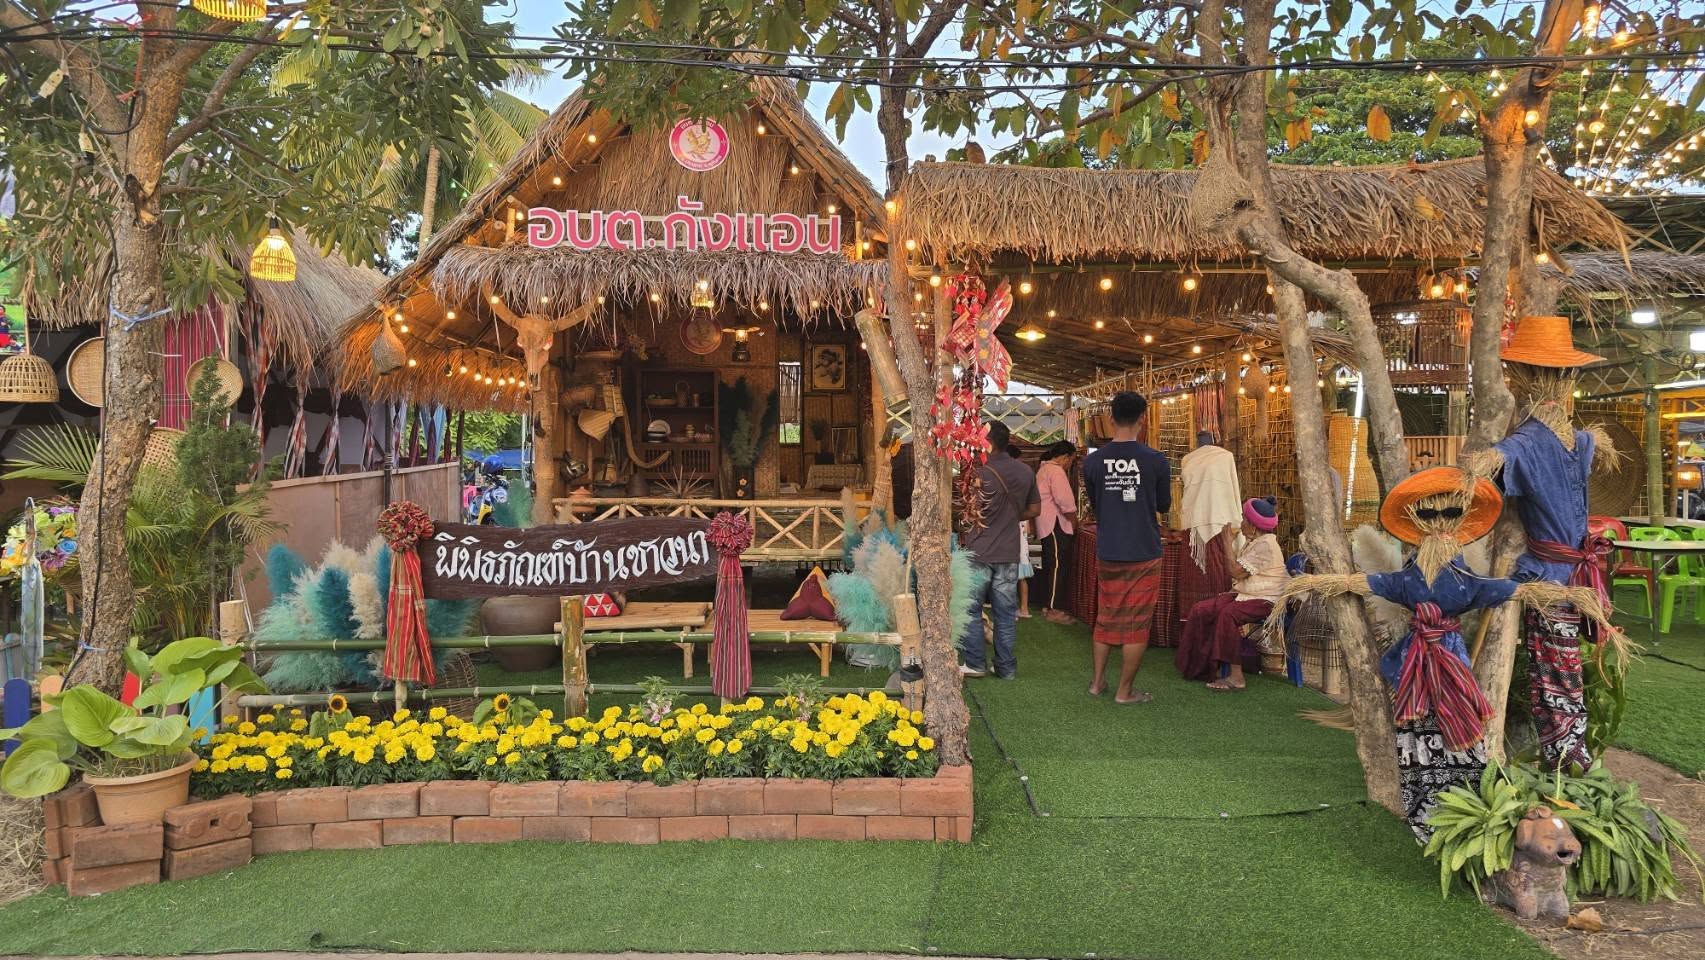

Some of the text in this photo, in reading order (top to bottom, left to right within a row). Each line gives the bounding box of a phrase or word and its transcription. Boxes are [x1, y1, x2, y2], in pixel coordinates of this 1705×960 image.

[527, 195, 842, 254] อบต.กังแอน
[1103, 459, 1140, 472] TOA
[434, 531, 709, 586] พิพิธภัณฑ์บ้านชาวนา
